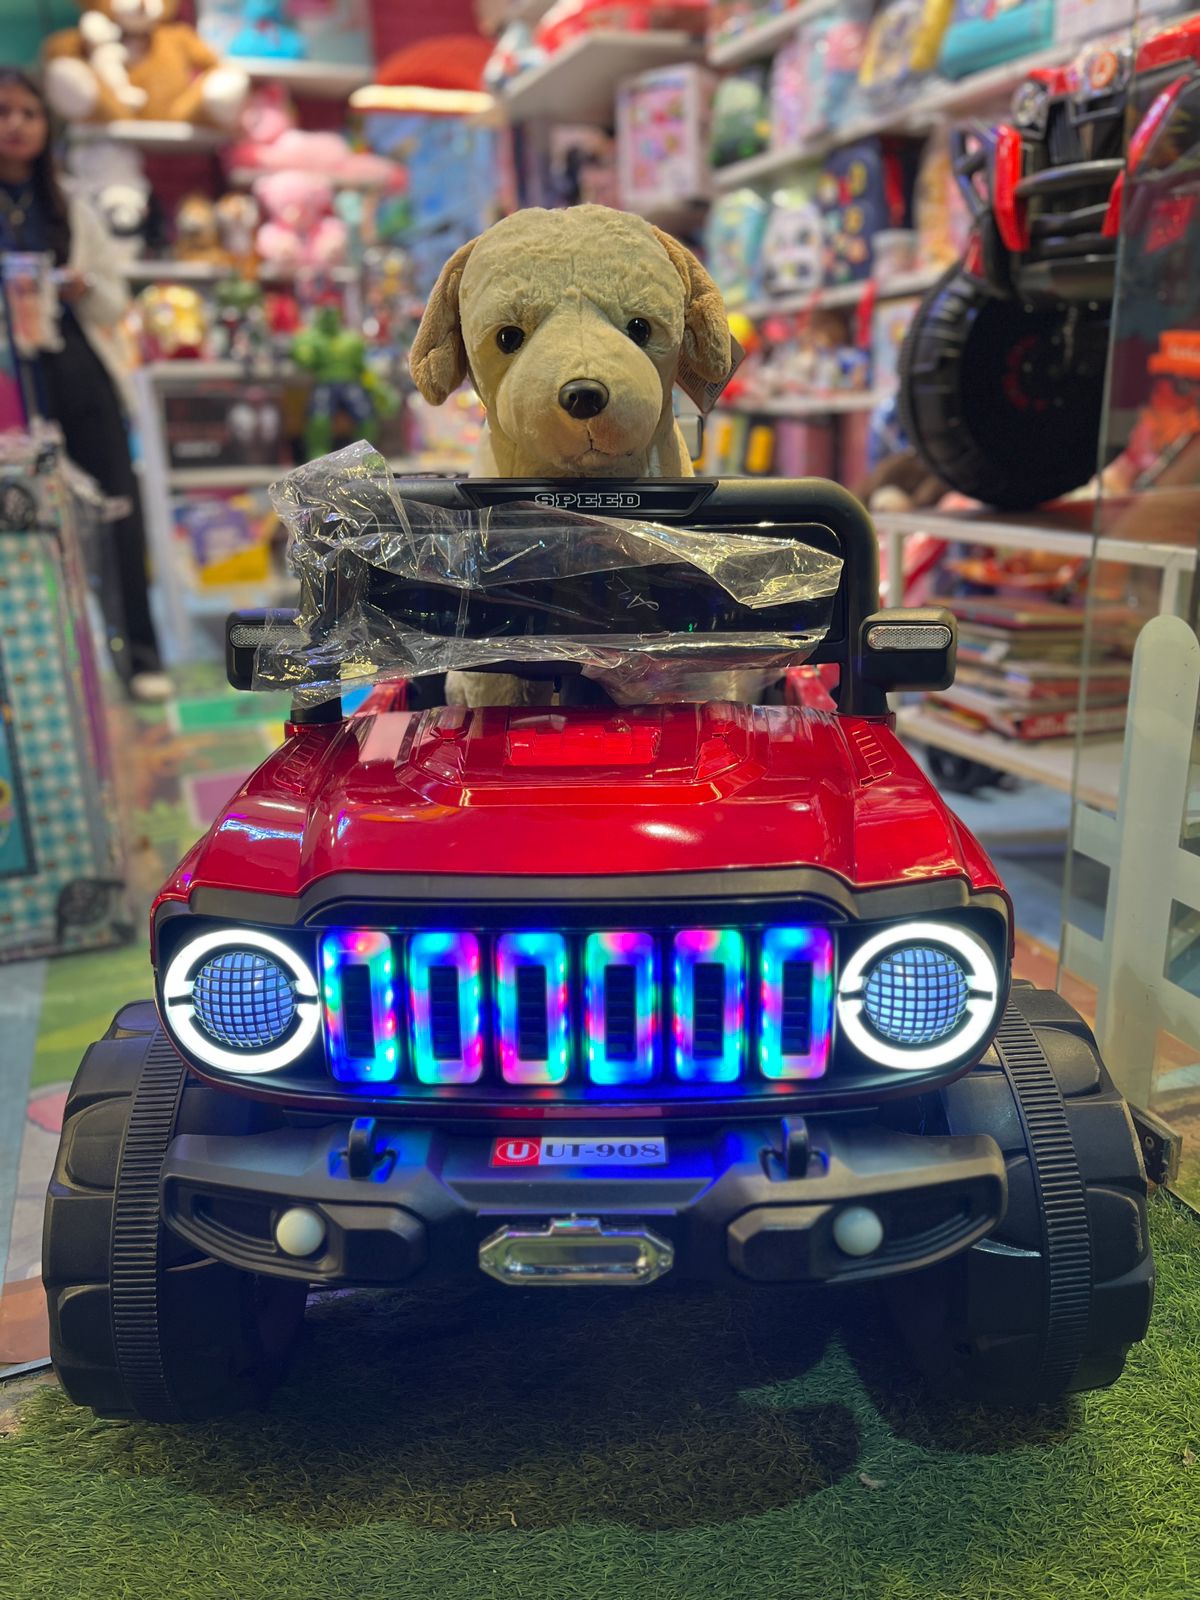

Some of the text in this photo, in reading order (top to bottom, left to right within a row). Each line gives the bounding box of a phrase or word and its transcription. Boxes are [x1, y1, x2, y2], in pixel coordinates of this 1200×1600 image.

[535, 493, 640, 508] SPEED
[507, 1144, 660, 1158] U UT-908
